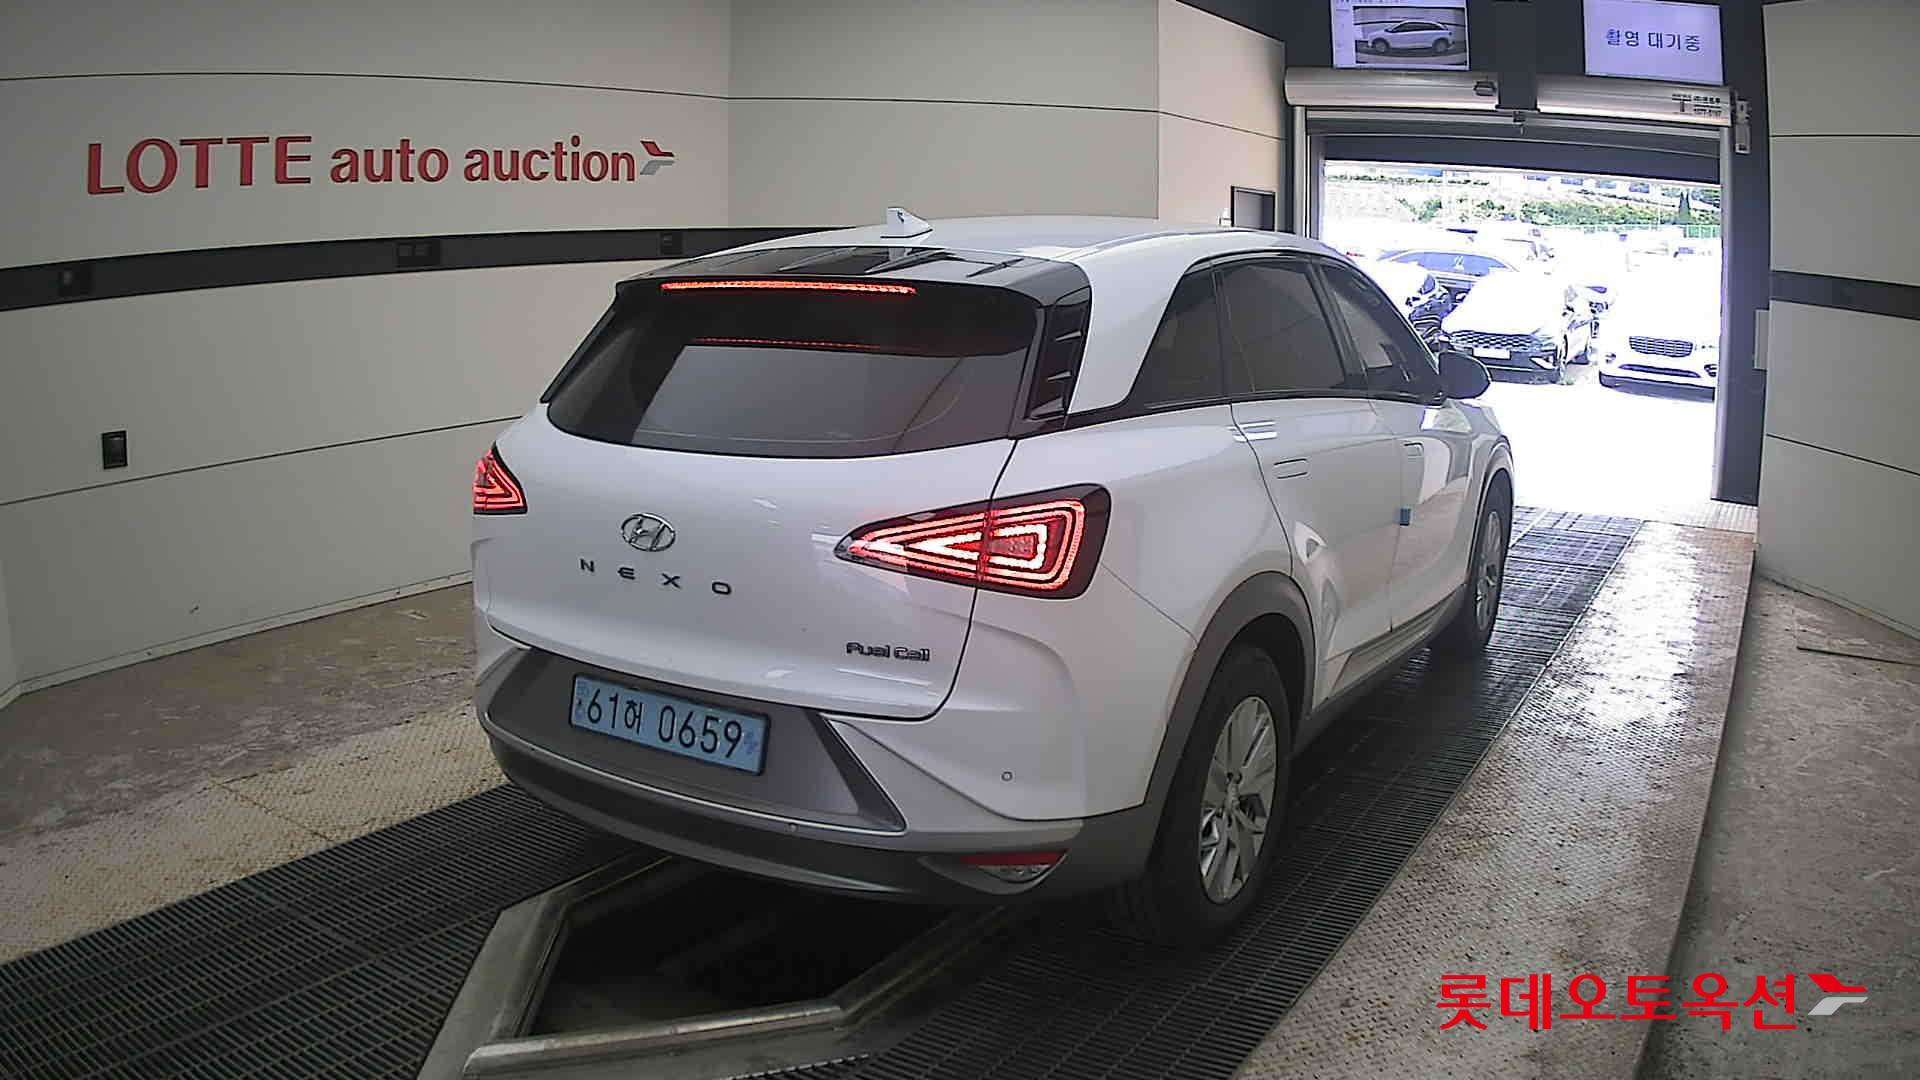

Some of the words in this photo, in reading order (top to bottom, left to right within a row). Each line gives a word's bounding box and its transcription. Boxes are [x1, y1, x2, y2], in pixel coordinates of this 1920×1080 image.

[1647, 31, 1701, 52] 대기중
[87, 135, 312, 196] LOTTE
[329, 138, 450, 184] auto
[462, 134, 636, 183] auction
[579, 558, 733, 596] NEXO
[586, 688, 643, 736] 61허
[658, 704, 743, 759] 0659
